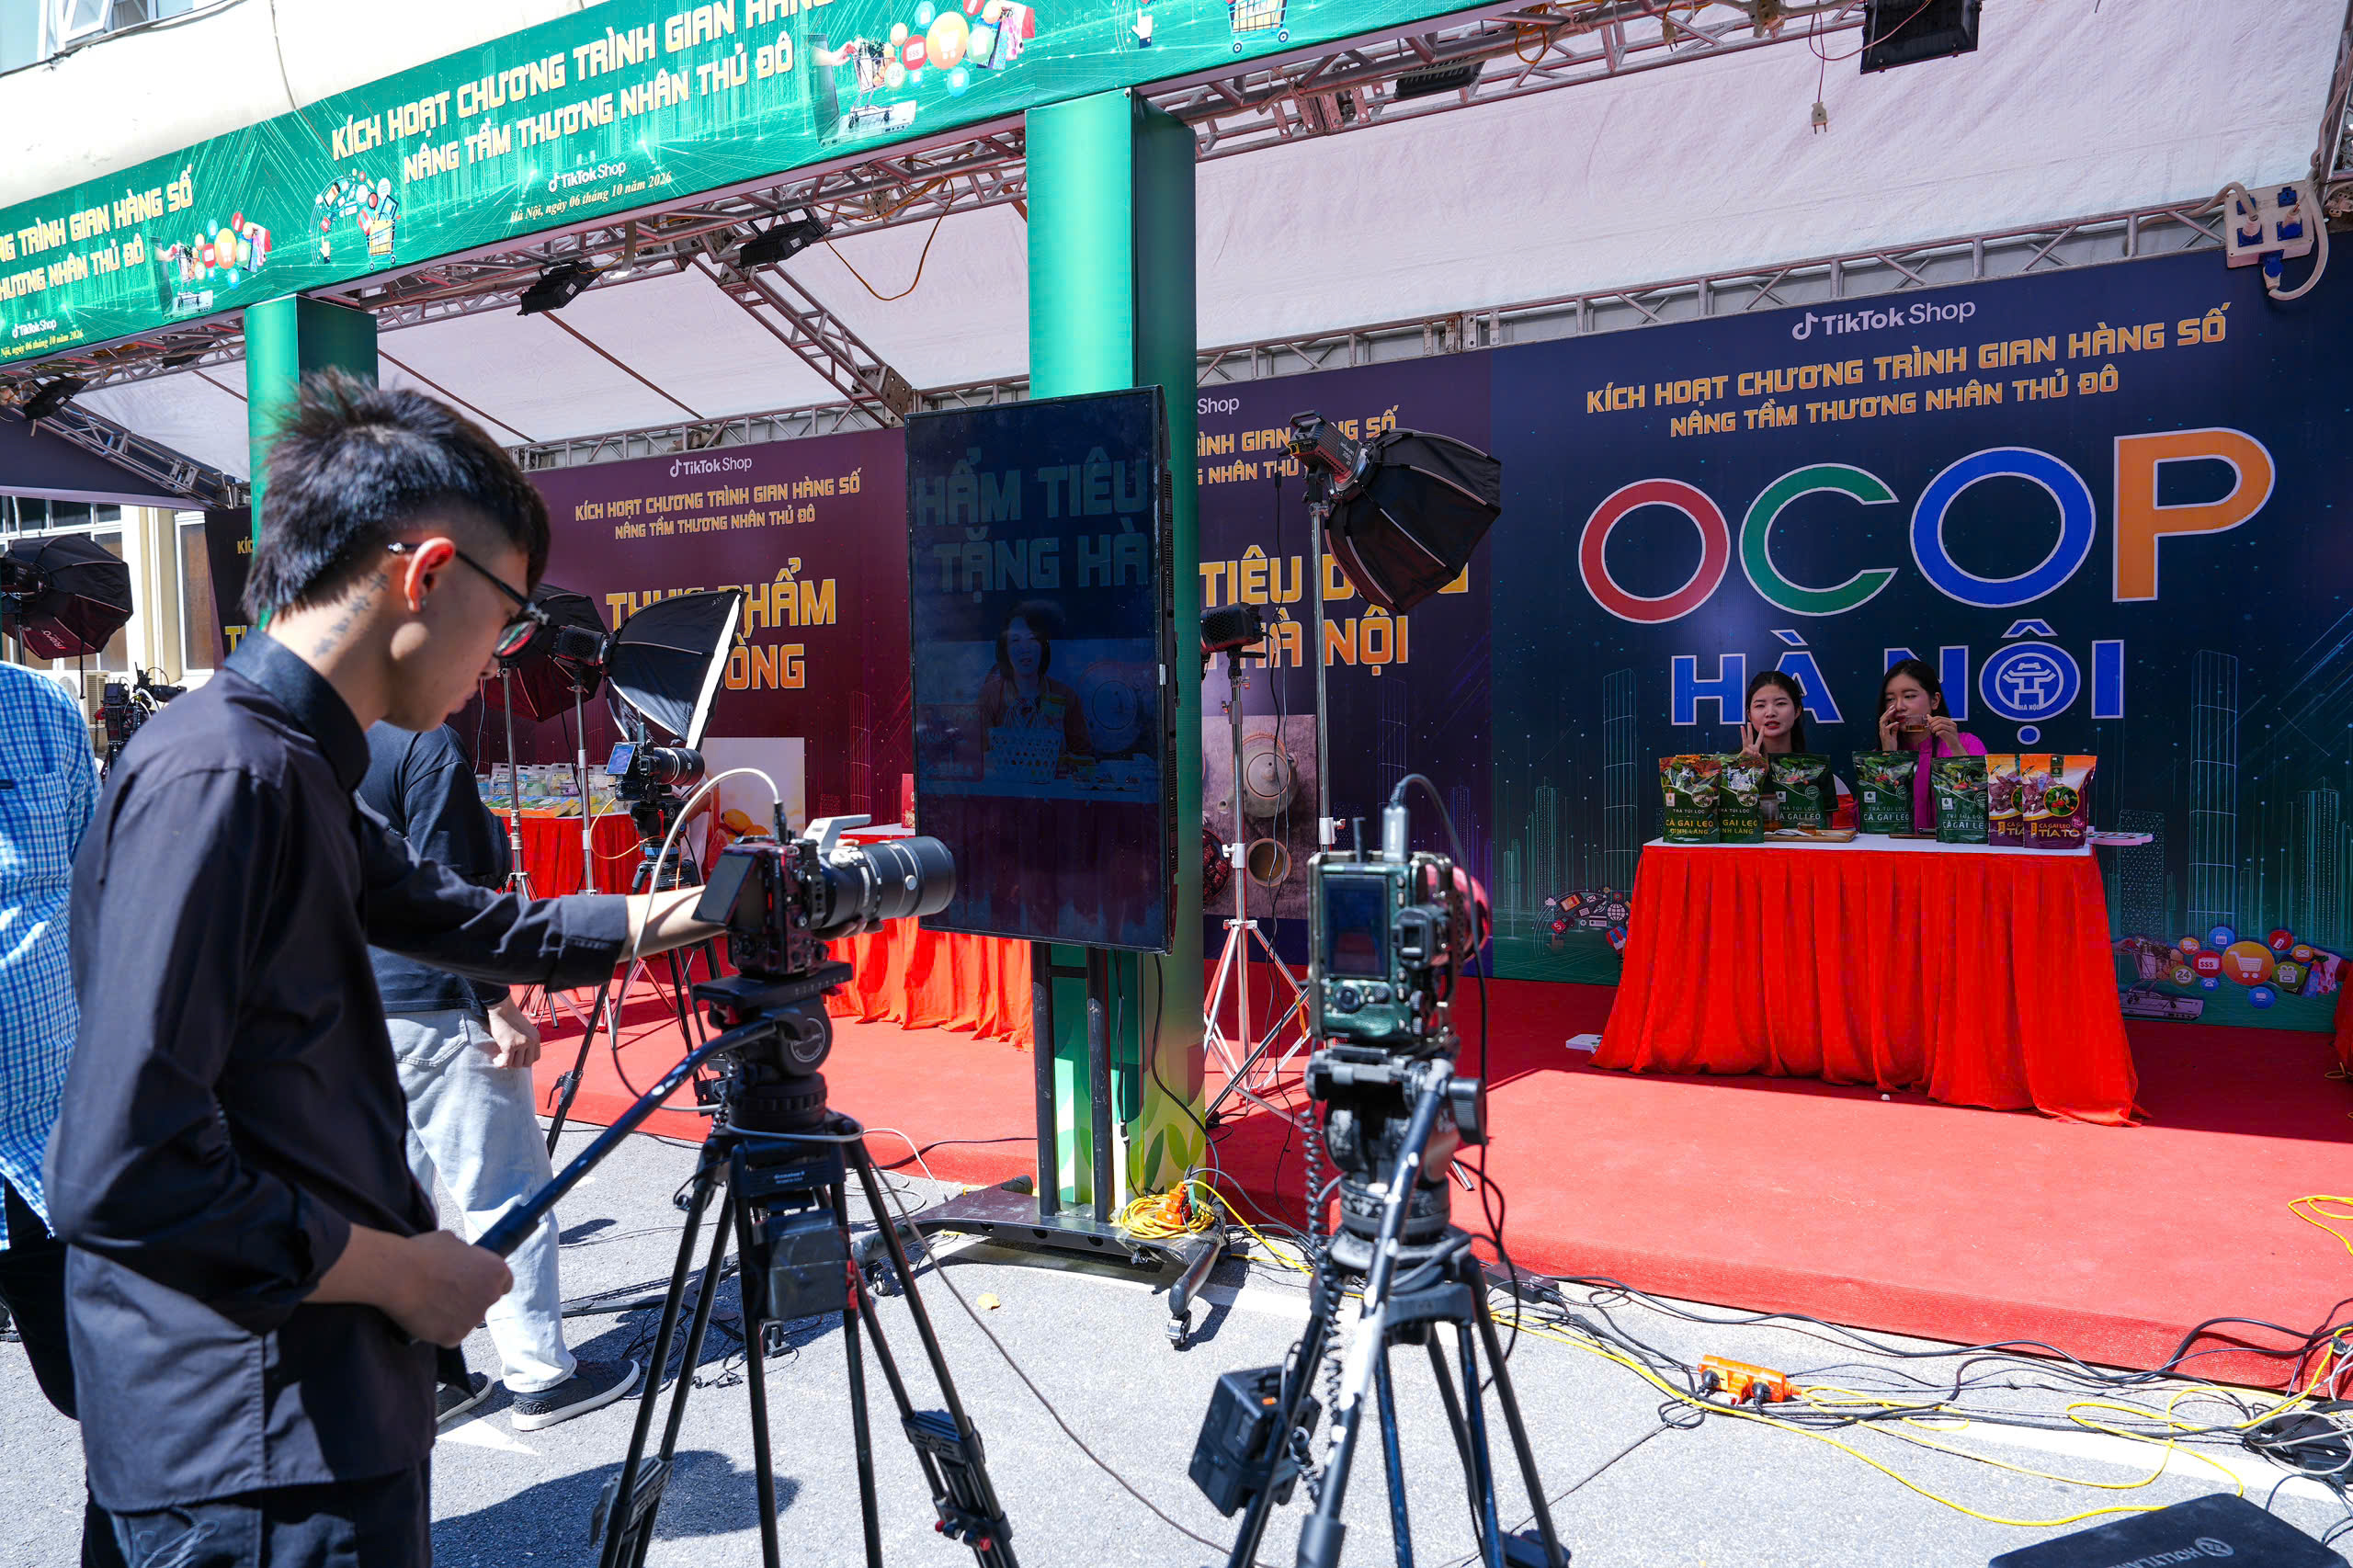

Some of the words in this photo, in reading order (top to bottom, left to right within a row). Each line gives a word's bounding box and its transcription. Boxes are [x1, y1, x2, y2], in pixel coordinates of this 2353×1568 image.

[331, 114, 382, 161] KÍCH
[387, 90, 450, 141] HOẠT
[457, 53, 566, 119] CHƯƠNG
[573, 23, 656, 81] TRÌNH
[665, 0, 735, 53] GIAN
[404, 142, 460, 183] NÂNG
[464, 117, 512, 165] TẦM
[517, 93, 614, 147] THƯƠNG
[620, 67, 689, 119] NHÂN
[697, 42, 748, 96] THỦ
[756, 30, 794, 80] ĐÔ
[510, 211, 524, 223] Hà
[545, 199, 568, 215] ngày
[569, 196, 581, 208] 06
[582, 189, 608, 204] tháng
[611, 184, 623, 197] 10
[625, 180, 646, 195] năm
[648, 171, 673, 188] 2026
[561, 167, 597, 188] TikTok
[597, 162, 627, 180] Shop
[17, 217, 67, 256] TRÌNH
[69, 204, 111, 243] GIAN
[113, 187, 165, 231] HÀNG
[166, 163, 193, 213] SỐ
[48, 251, 89, 289] NHÂN
[91, 238, 120, 277] THỦ
[122, 232, 146, 267] ĐÔ
[40, 319, 57, 332] Shop
[1822, 306, 1906, 335] TikTok
[1909, 301, 1976, 325] Shop
[1586, 381, 1645, 414] KÍCH
[1654, 374, 1729, 407] HOẠT
[1737, 358, 1864, 398] CHƯƠNG
[1873, 345, 1967, 381] TRÌNH
[1978, 335, 2057, 369] GIAN
[2068, 322, 2165, 359] HÀNG
[2177, 301, 2232, 347] SỐ
[1197, 397, 1240, 415] Shop
[1670, 410, 1736, 437] NÂNG
[1744, 397, 1799, 431] TẦM
[1805, 392, 1917, 424] THƯƠNG
[1926, 379, 2003, 413] NHÂN
[2012, 368, 2069, 402] THỦ
[2077, 363, 2120, 395] ĐÔ
[1198, 431, 1235, 457] ÌNH
[1242, 426, 1291, 452] GIAN
[1366, 404, 1400, 438] SỐ
[683, 459, 721, 475] TikTok
[722, 457, 753, 472] Shop
[1037, 446, 1148, 518] TIÊU
[1209, 459, 1258, 484] NHÂN
[574, 499, 604, 521] KÍCH
[607, 497, 642, 519] HOẠT
[645, 492, 703, 514] CHƯƠNG
[707, 484, 750, 507] TRÌNH
[753, 483, 789, 504] GIAN
[792, 476, 834, 499] HÀNG
[838, 467, 862, 494] SỐ
[236, 536, 254, 554] KÍC
[615, 521, 646, 540] NÂNG
[649, 516, 675, 537] TẦM
[677, 518, 728, 535] THƯƠNG
[731, 509, 766, 529] NHÂN
[768, 505, 794, 525] THỦ
[797, 503, 816, 523] ĐÔ
[1578, 426, 2277, 624] OCOP
[1076, 517, 1148, 589] HÀ
[1199, 544, 1302, 608] TIÊU
[718, 557, 836, 628] HẨM
[1324, 603, 1409, 676] NỘI
[1670, 629, 1845, 726] HÀ
[1677, 819, 1693, 827] GAI
[1697, 820, 1714, 828] LEO
[1722, 819, 1738, 827] GAI
[1863, 812, 1874, 821] CÀ
[1952, 821, 1969, 829] GAI
[2177, 971, 2189, 979] 24
[2107, 1547, 2204, 1568] HOLLYLA
